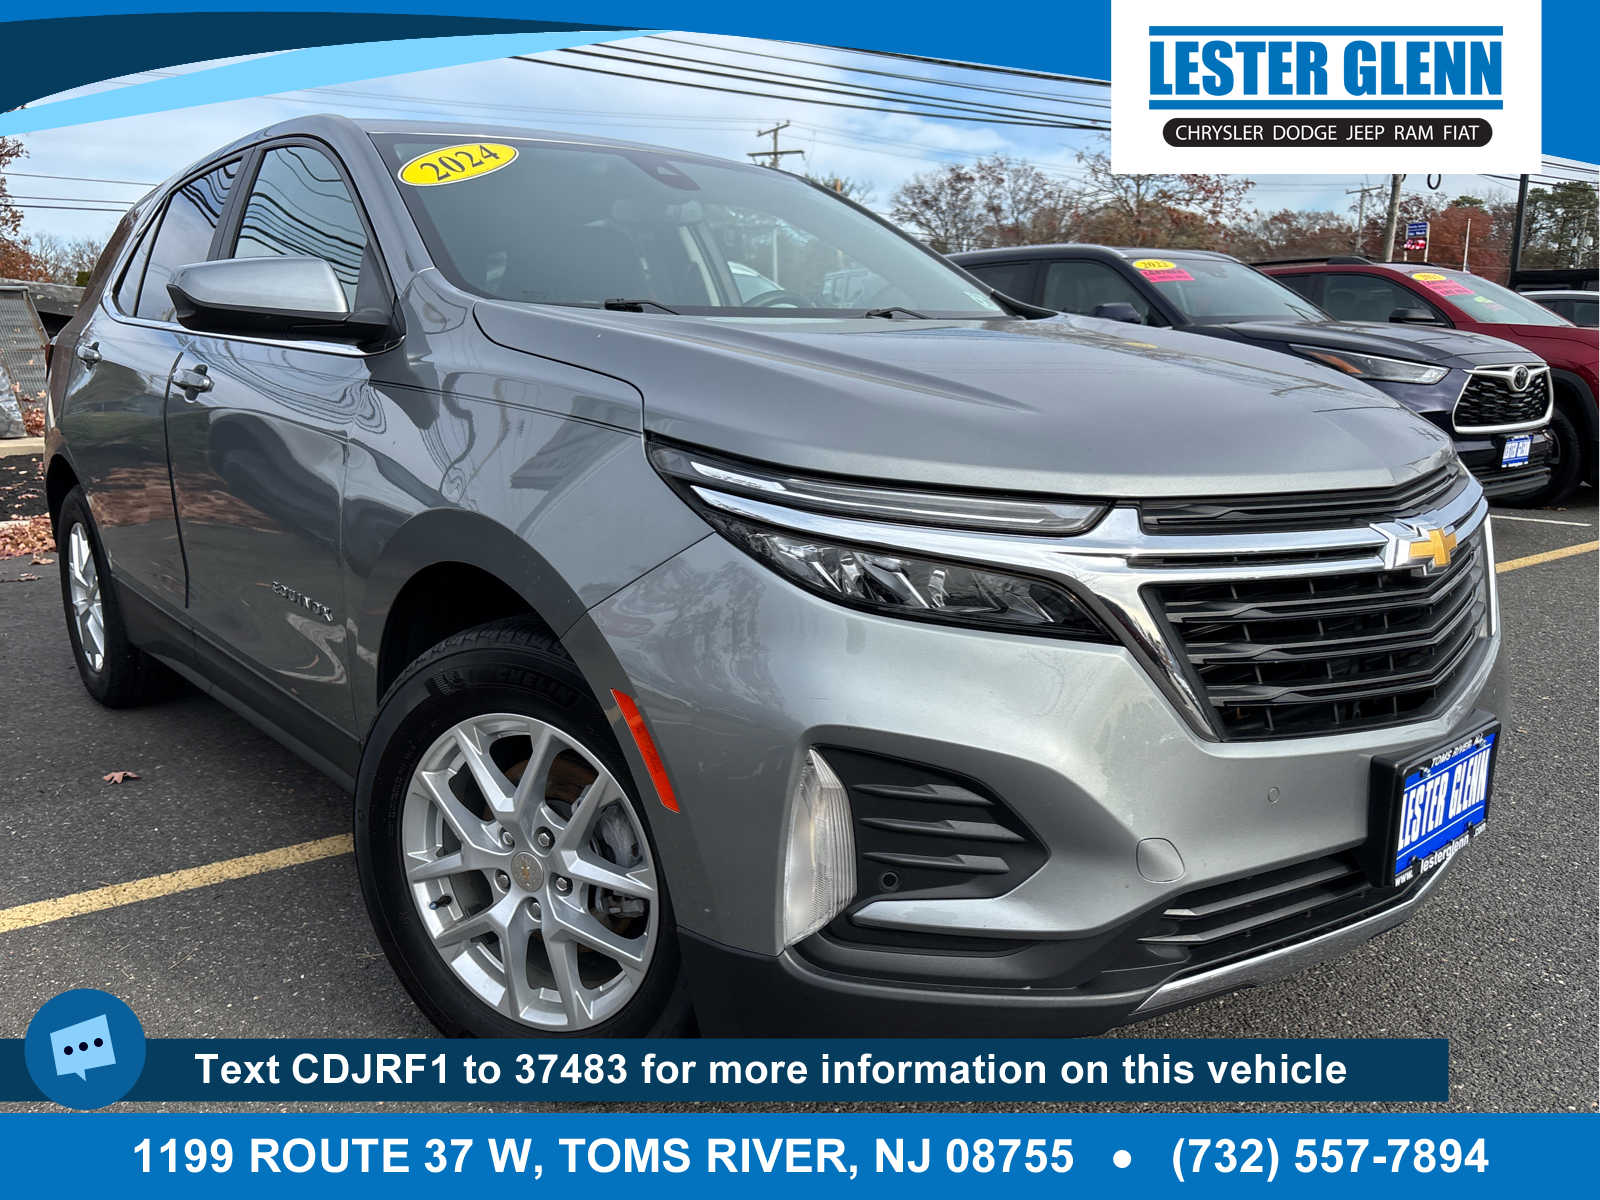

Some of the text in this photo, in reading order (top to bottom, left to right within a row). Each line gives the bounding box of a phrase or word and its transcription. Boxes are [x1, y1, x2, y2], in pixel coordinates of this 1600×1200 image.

[420, 145, 500, 181] 2024
[1431, 750, 1453, 768] TOMS
[1397, 747, 1491, 851] LESTER GLENN
